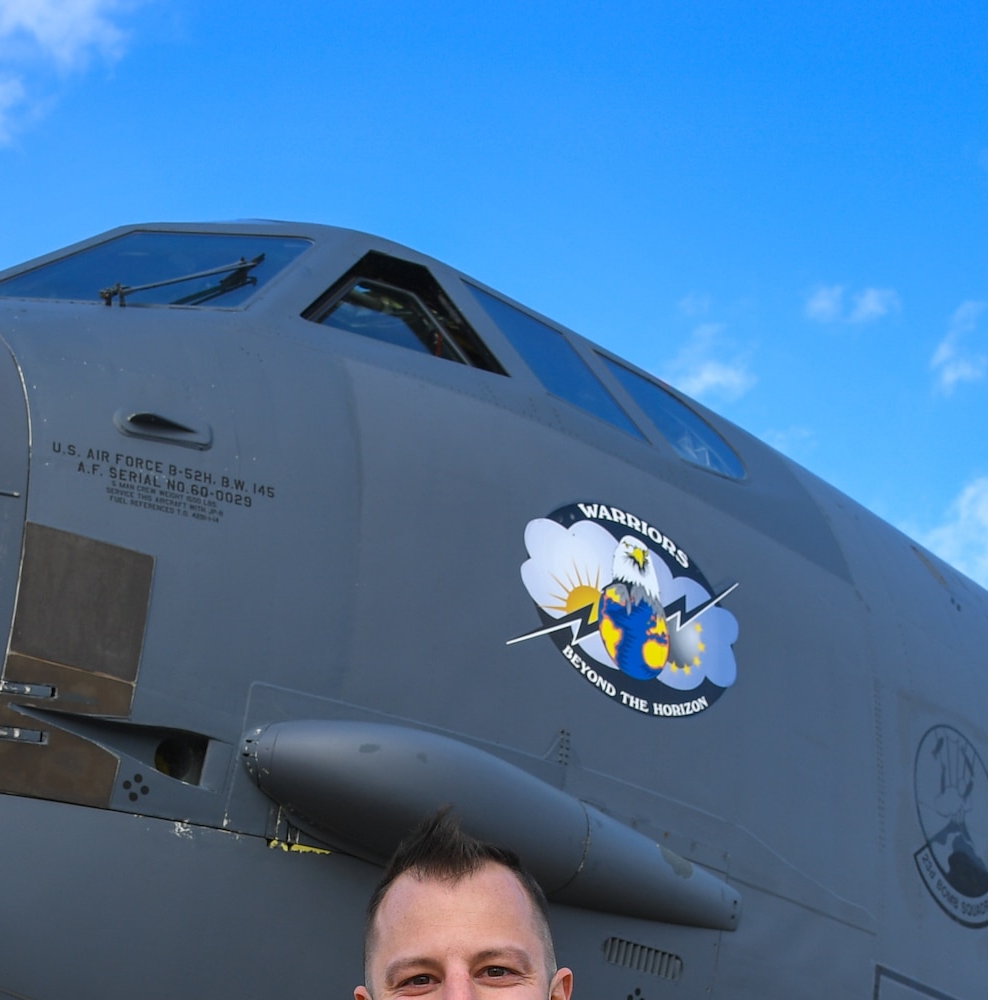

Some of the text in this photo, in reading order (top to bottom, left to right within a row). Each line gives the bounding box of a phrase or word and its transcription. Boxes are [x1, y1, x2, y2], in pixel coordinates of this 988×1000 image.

[52, 441, 81, 458] U.S.
[87, 448, 110, 463] AIR
[115, 453, 164, 474] FORCE
[221, 475, 248, 493] B.W.
[253, 482, 275, 499] 145
[77, 461, 104, 477] A.F.
[109, 467, 161, 488] SERIAL
[106, 486, 134, 498] SERVICE
[138, 492, 153, 502] THIS
[155, 497, 186, 509] AIRCRAFT
[190, 504, 206, 513] WITH
[109, 495, 128, 505] FUEL
[119, 481, 135, 490] MAN
[137, 484, 156, 495] CREW
[159, 490, 184, 501] WEIGHT
[577, 503, 689, 569] WARRIORS
[562, 645, 709, 717] BEYOND THE HORIZON
[936, 878, 959, 910] BOMB
